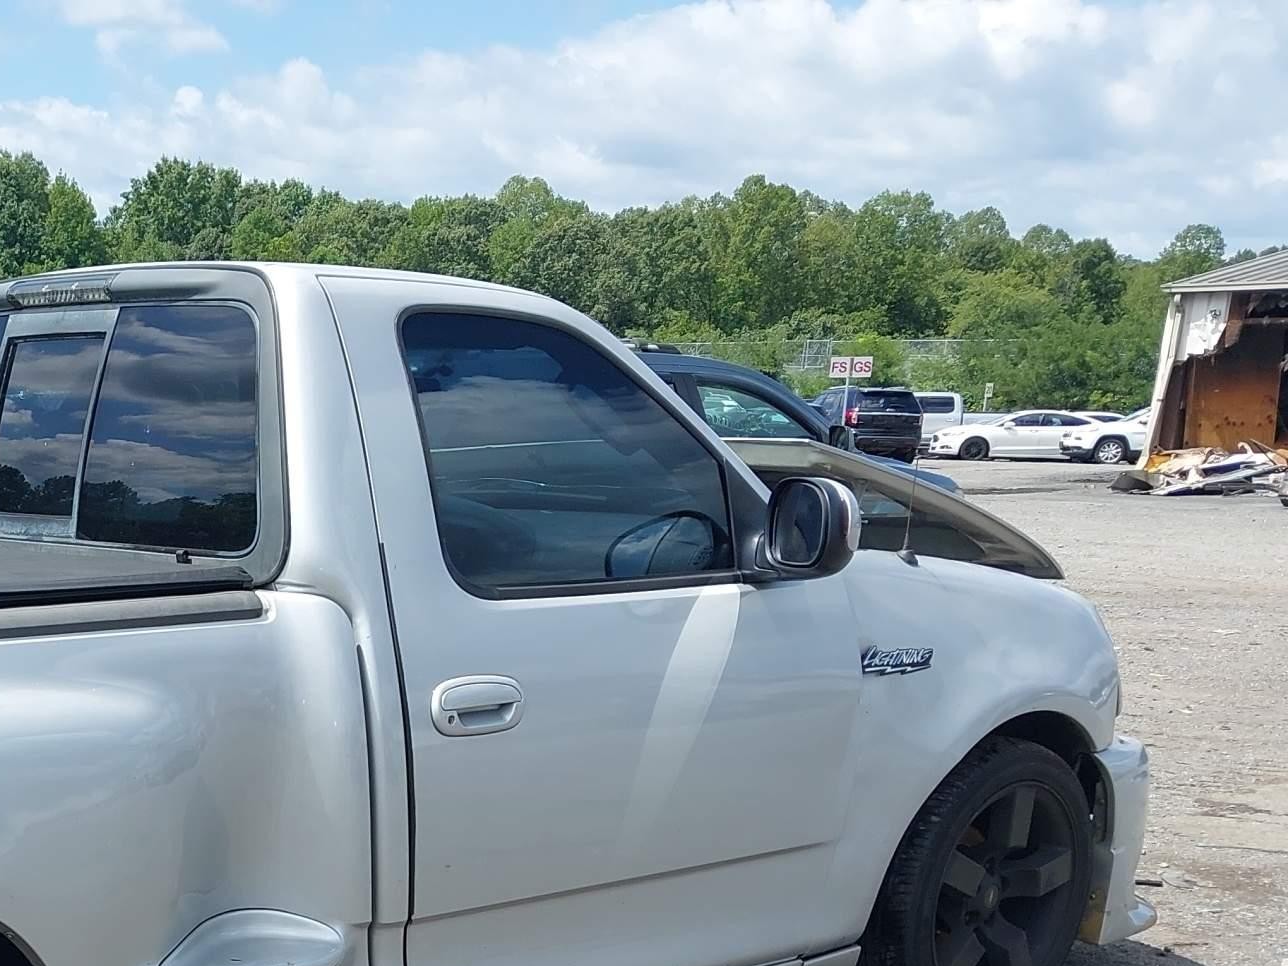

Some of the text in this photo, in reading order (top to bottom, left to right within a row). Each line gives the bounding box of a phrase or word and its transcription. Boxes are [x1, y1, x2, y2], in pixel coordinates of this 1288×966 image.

[831, 361, 848, 373] FS
[854, 360, 872, 373] GS
[863, 645, 933, 667] LIGHTNING
